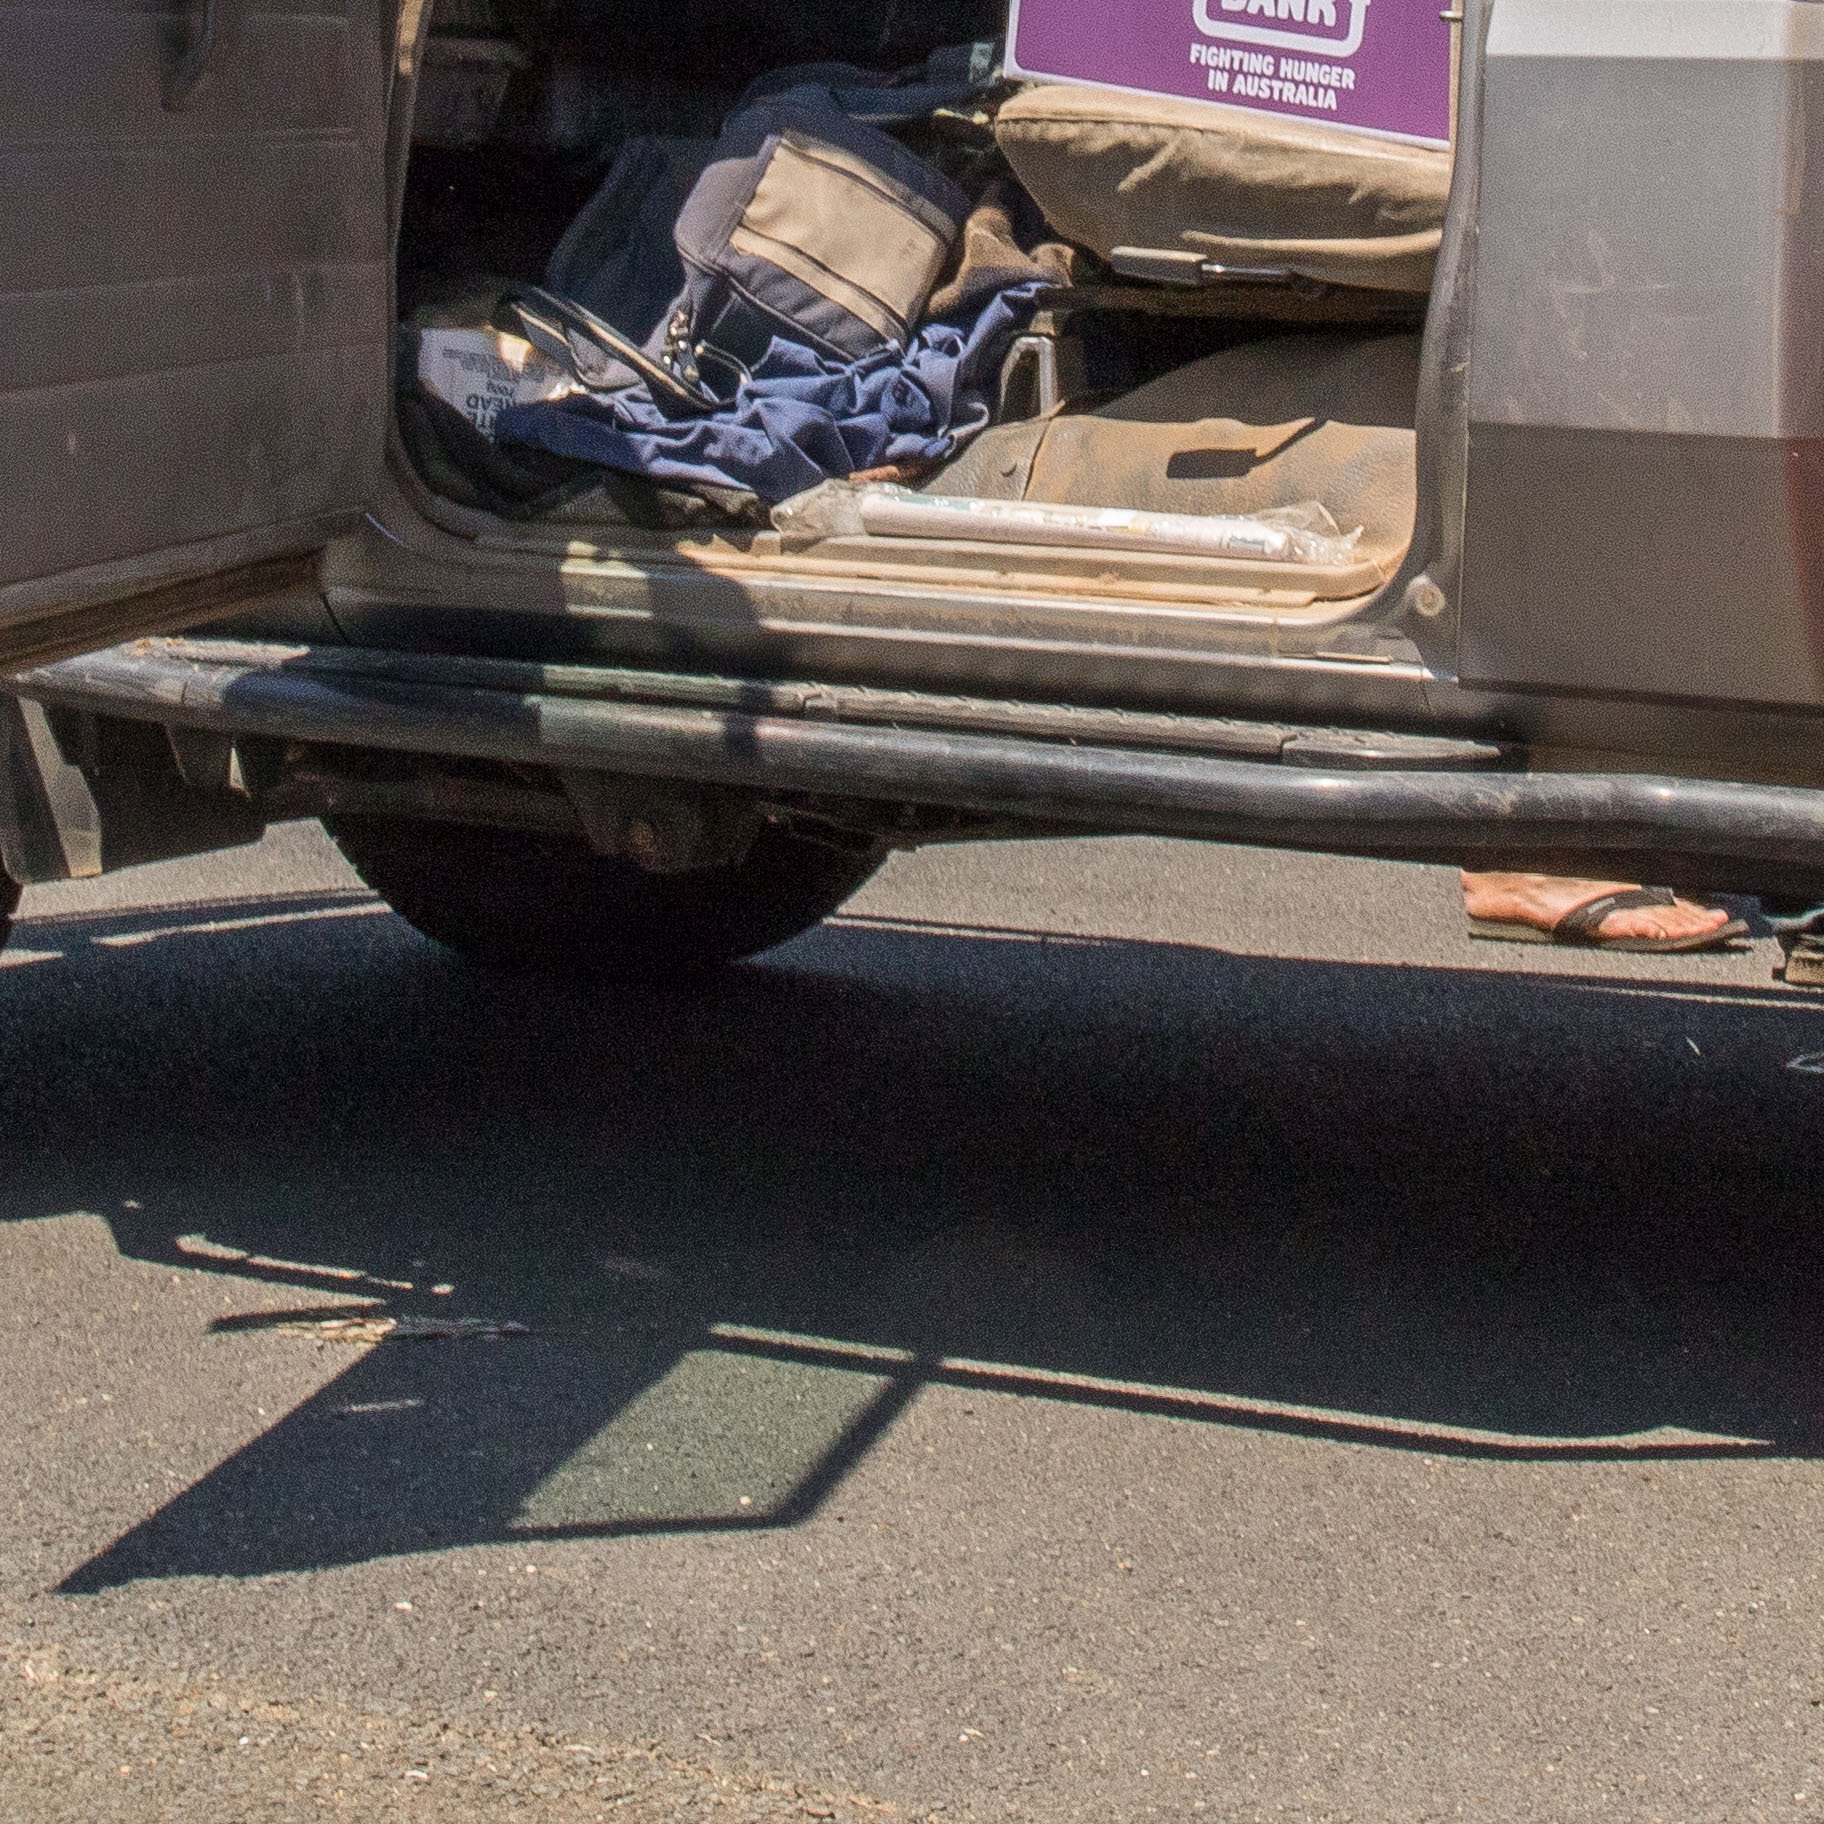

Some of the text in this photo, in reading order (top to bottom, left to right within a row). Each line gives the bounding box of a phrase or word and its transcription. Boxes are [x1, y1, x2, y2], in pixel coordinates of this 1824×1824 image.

[1189, 42, 1356, 90] FIGHTING HUNGER
[1207, 68, 1339, 110] IN AUSTRALIA
